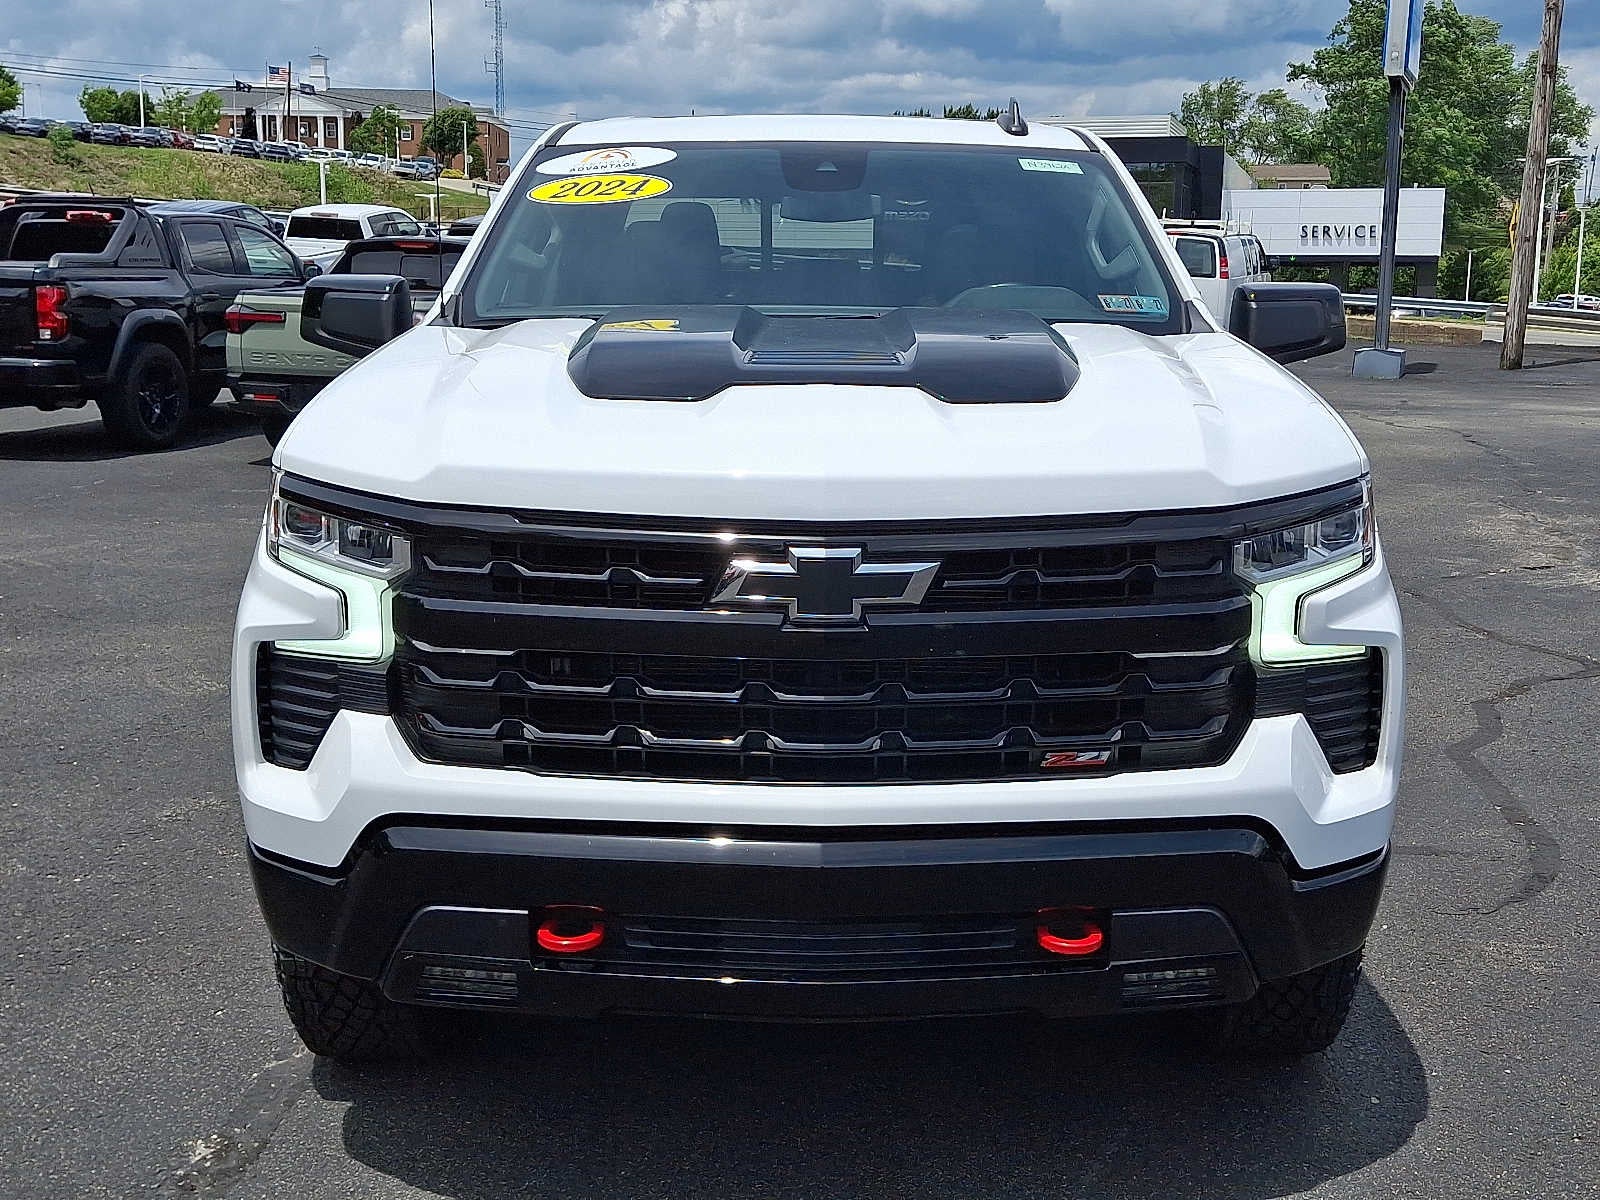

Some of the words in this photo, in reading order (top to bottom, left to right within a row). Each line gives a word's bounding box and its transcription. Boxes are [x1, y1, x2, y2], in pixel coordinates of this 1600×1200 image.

[549, 178, 651, 199] 2024
[1299, 225, 1377, 239] SERVICE
[1040, 751, 1112, 767] Z71
